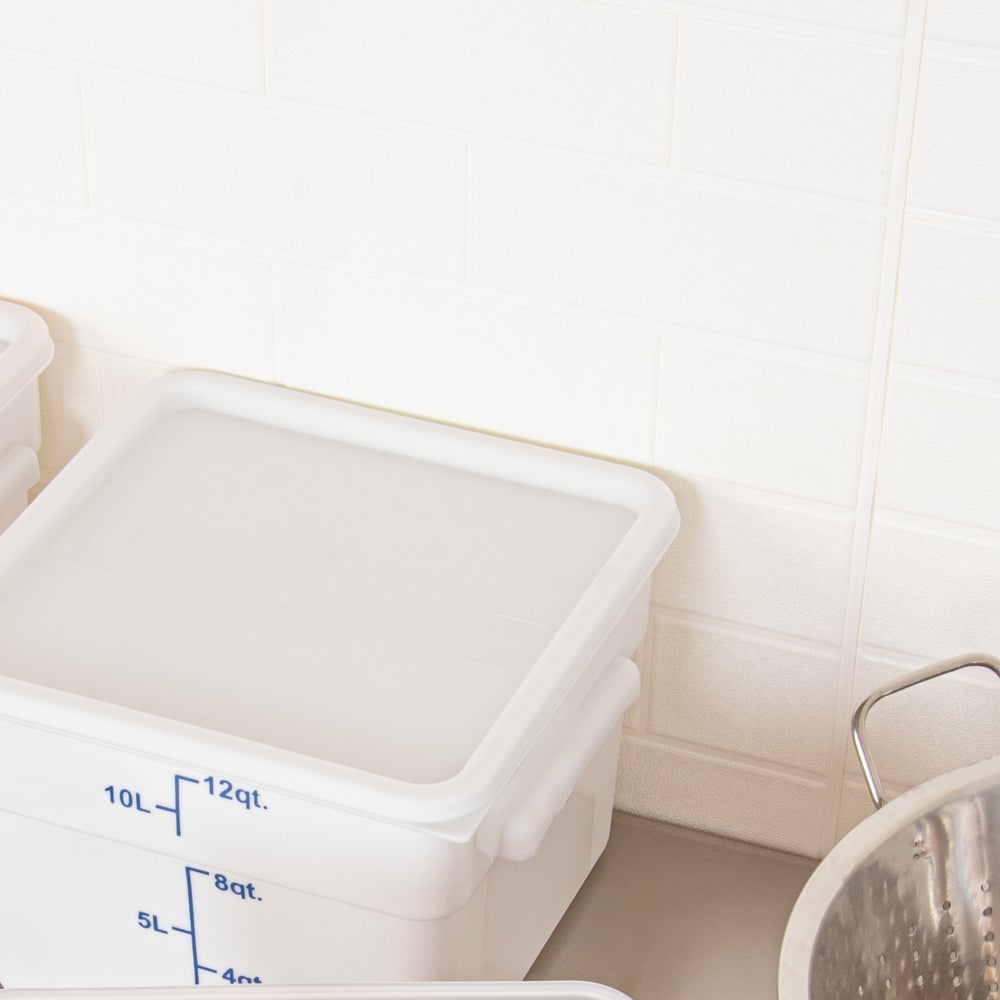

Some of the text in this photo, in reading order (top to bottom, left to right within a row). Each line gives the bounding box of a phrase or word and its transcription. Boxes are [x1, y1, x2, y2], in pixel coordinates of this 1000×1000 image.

[104, 785, 152, 814] 10L
[203, 776, 269, 811] 12qt.
[213, 873, 263, 902] 8qt.
[137, 911, 169, 935] 5L
